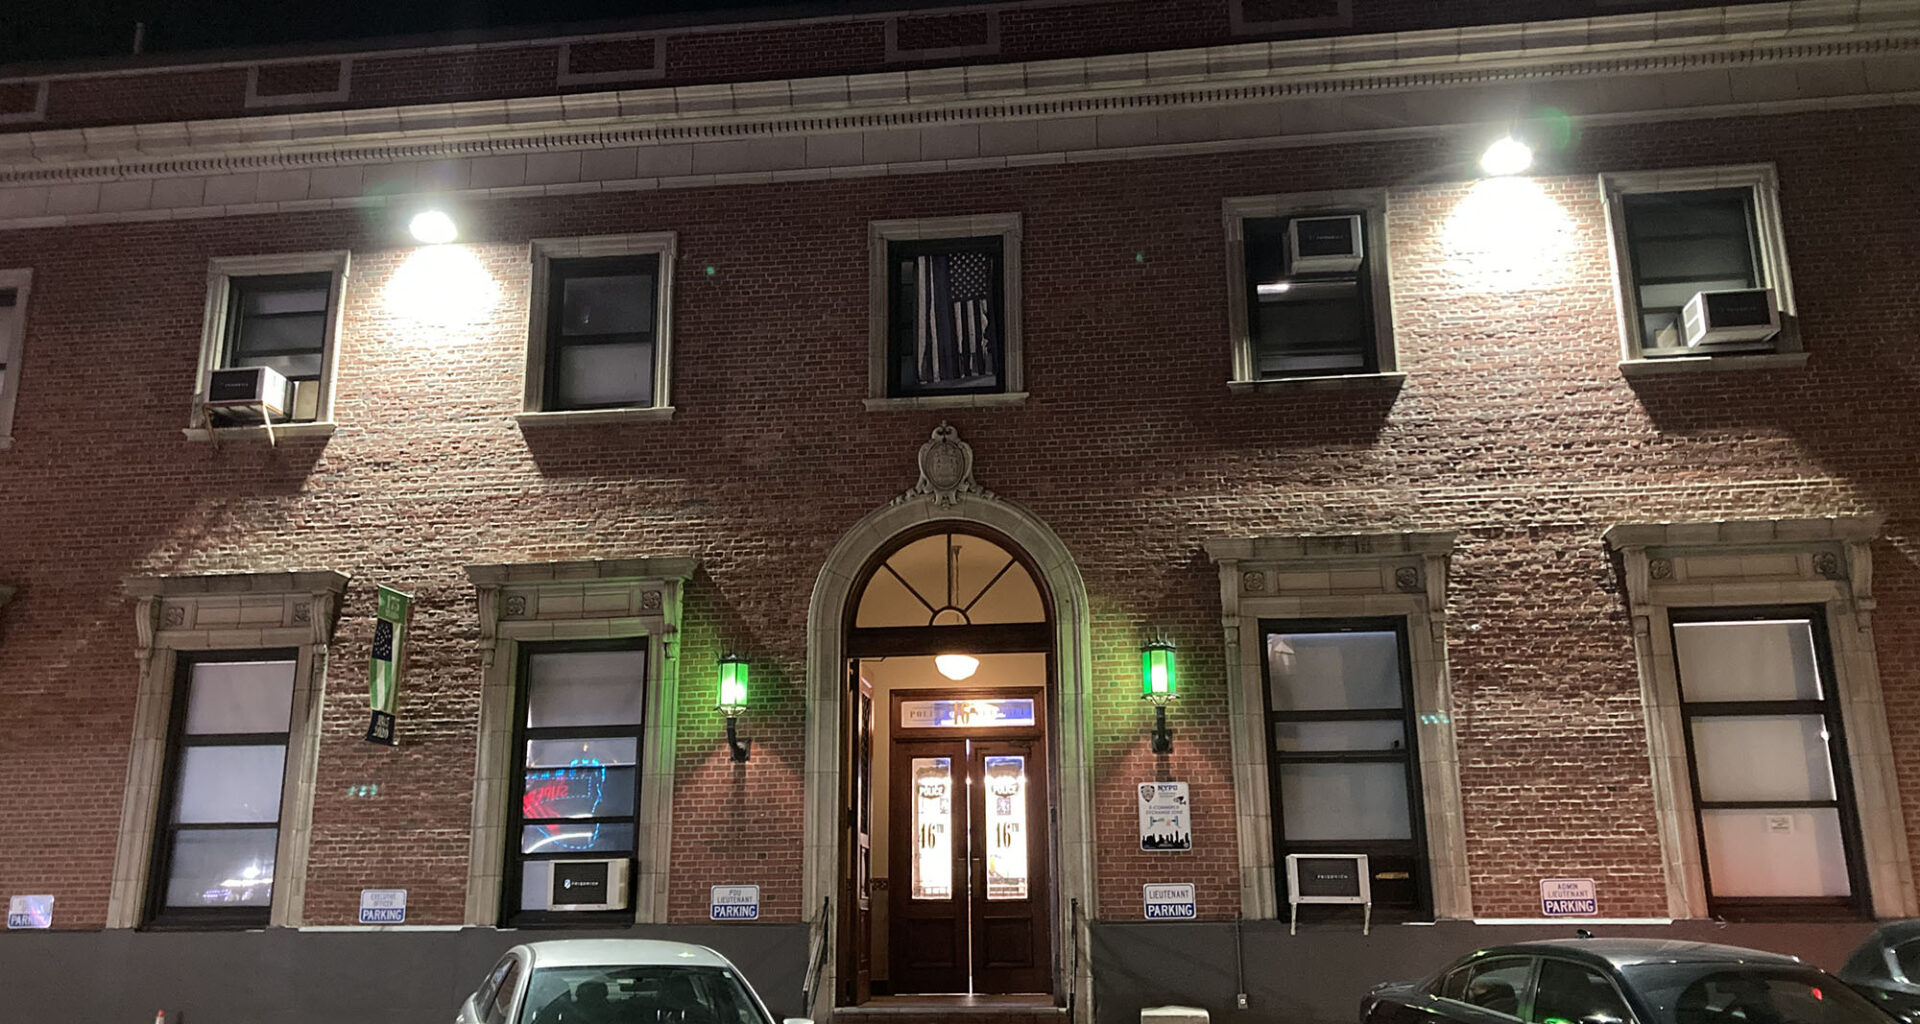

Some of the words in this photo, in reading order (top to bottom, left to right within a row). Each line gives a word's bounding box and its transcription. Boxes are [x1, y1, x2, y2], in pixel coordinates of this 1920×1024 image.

[1149, 890, 1189, 899] LIEUTENANT
[1548, 890, 1588, 898] LIEUTENANT
[714, 905, 756, 917] PARKING
[1147, 904, 1193, 917] PARKING
[1545, 900, 1594, 912] PARKING
[363, 909, 402, 921] PARKING
